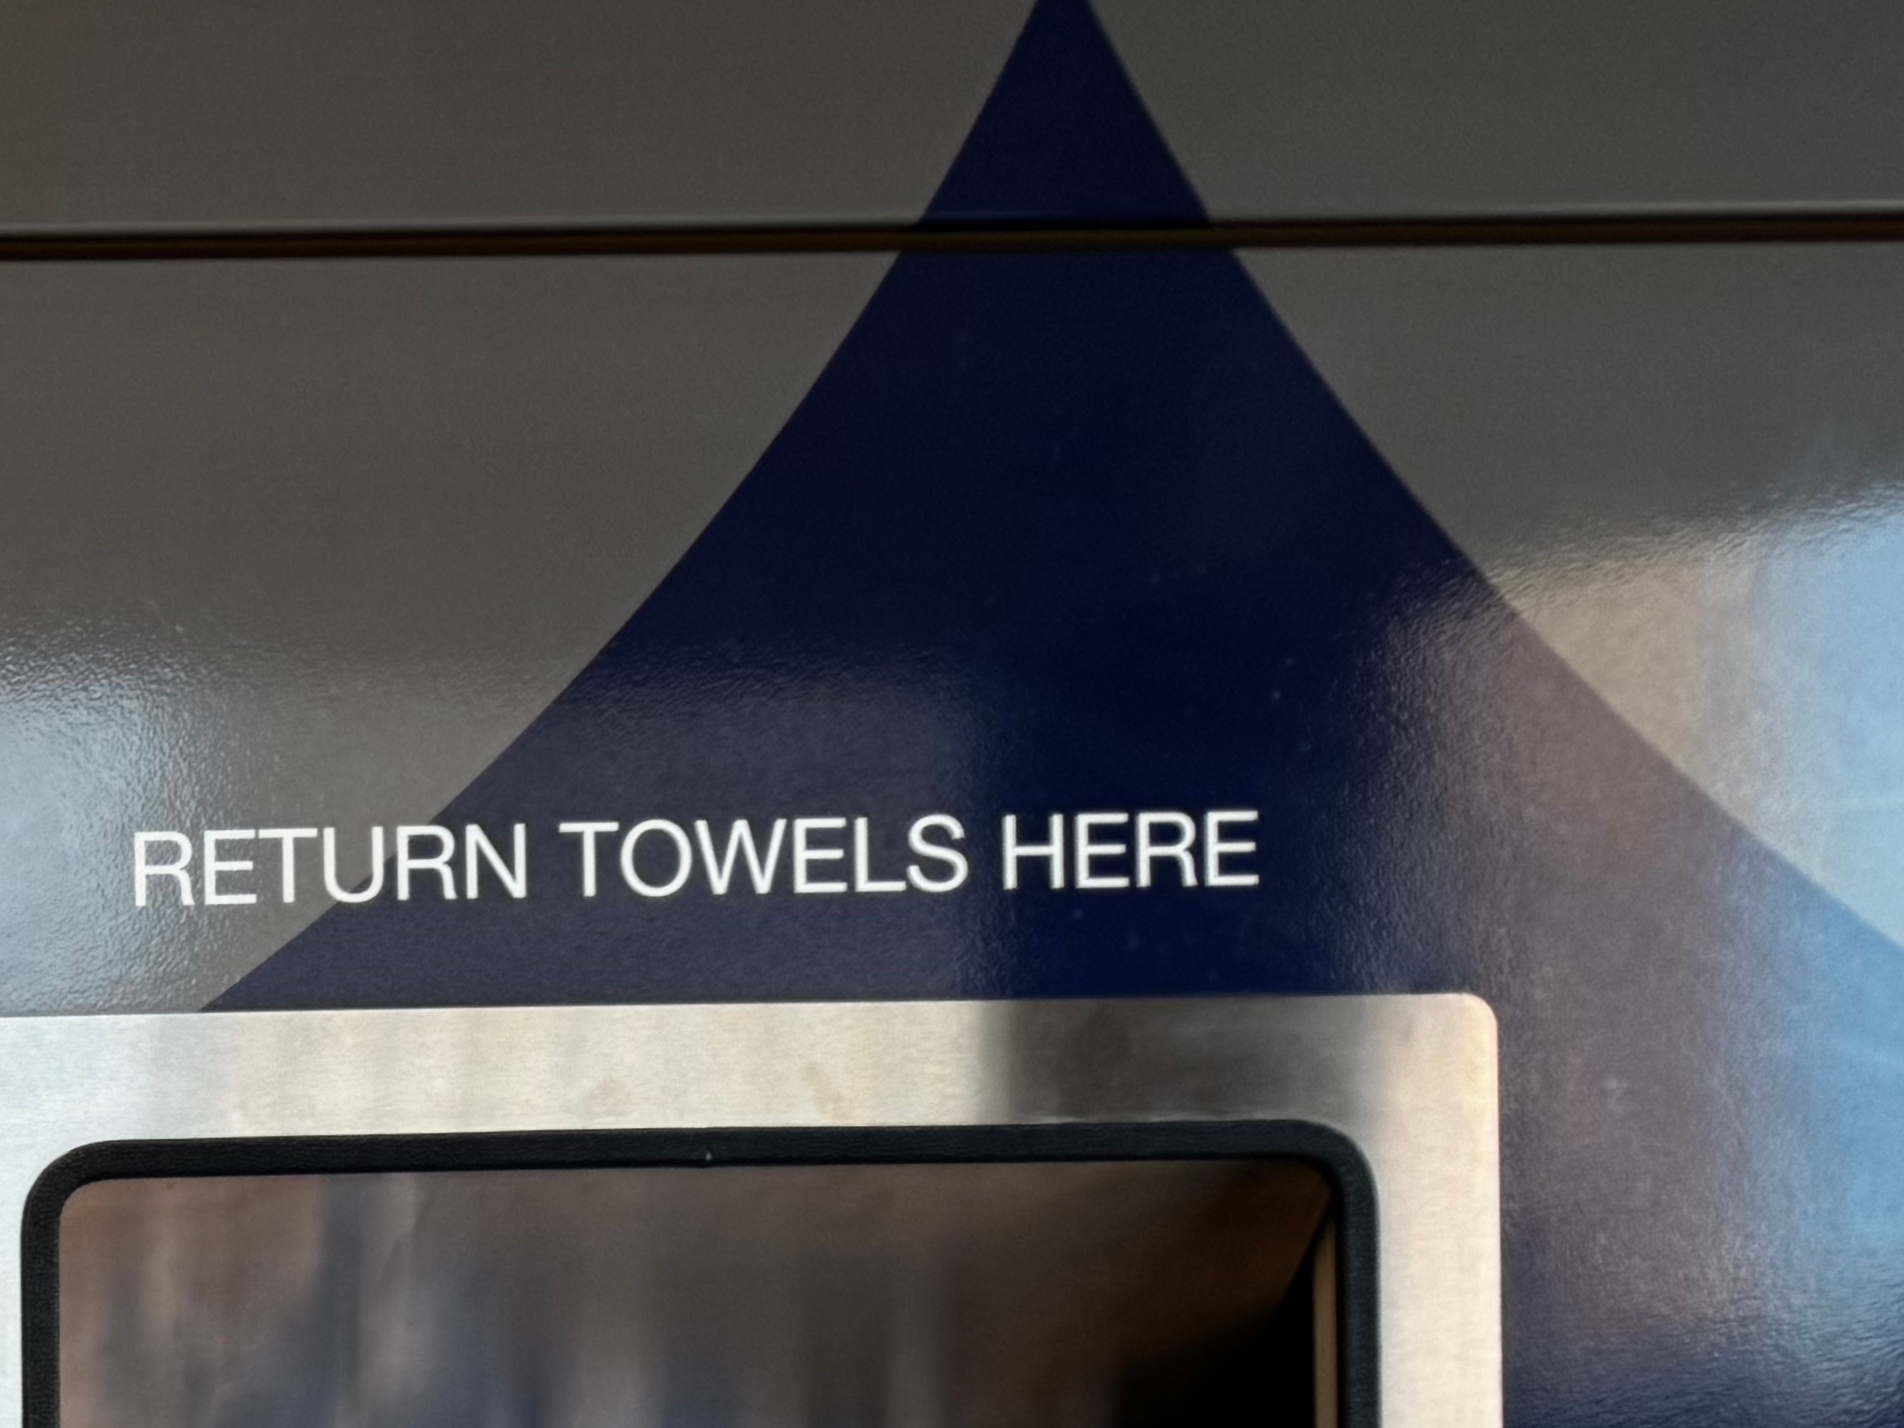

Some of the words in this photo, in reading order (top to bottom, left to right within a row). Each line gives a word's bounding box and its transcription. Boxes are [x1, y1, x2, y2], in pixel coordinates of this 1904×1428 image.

[132, 821, 528, 908] RETURN
[557, 812, 969, 899] TOWELS
[1003, 808, 1261, 890] HERE
